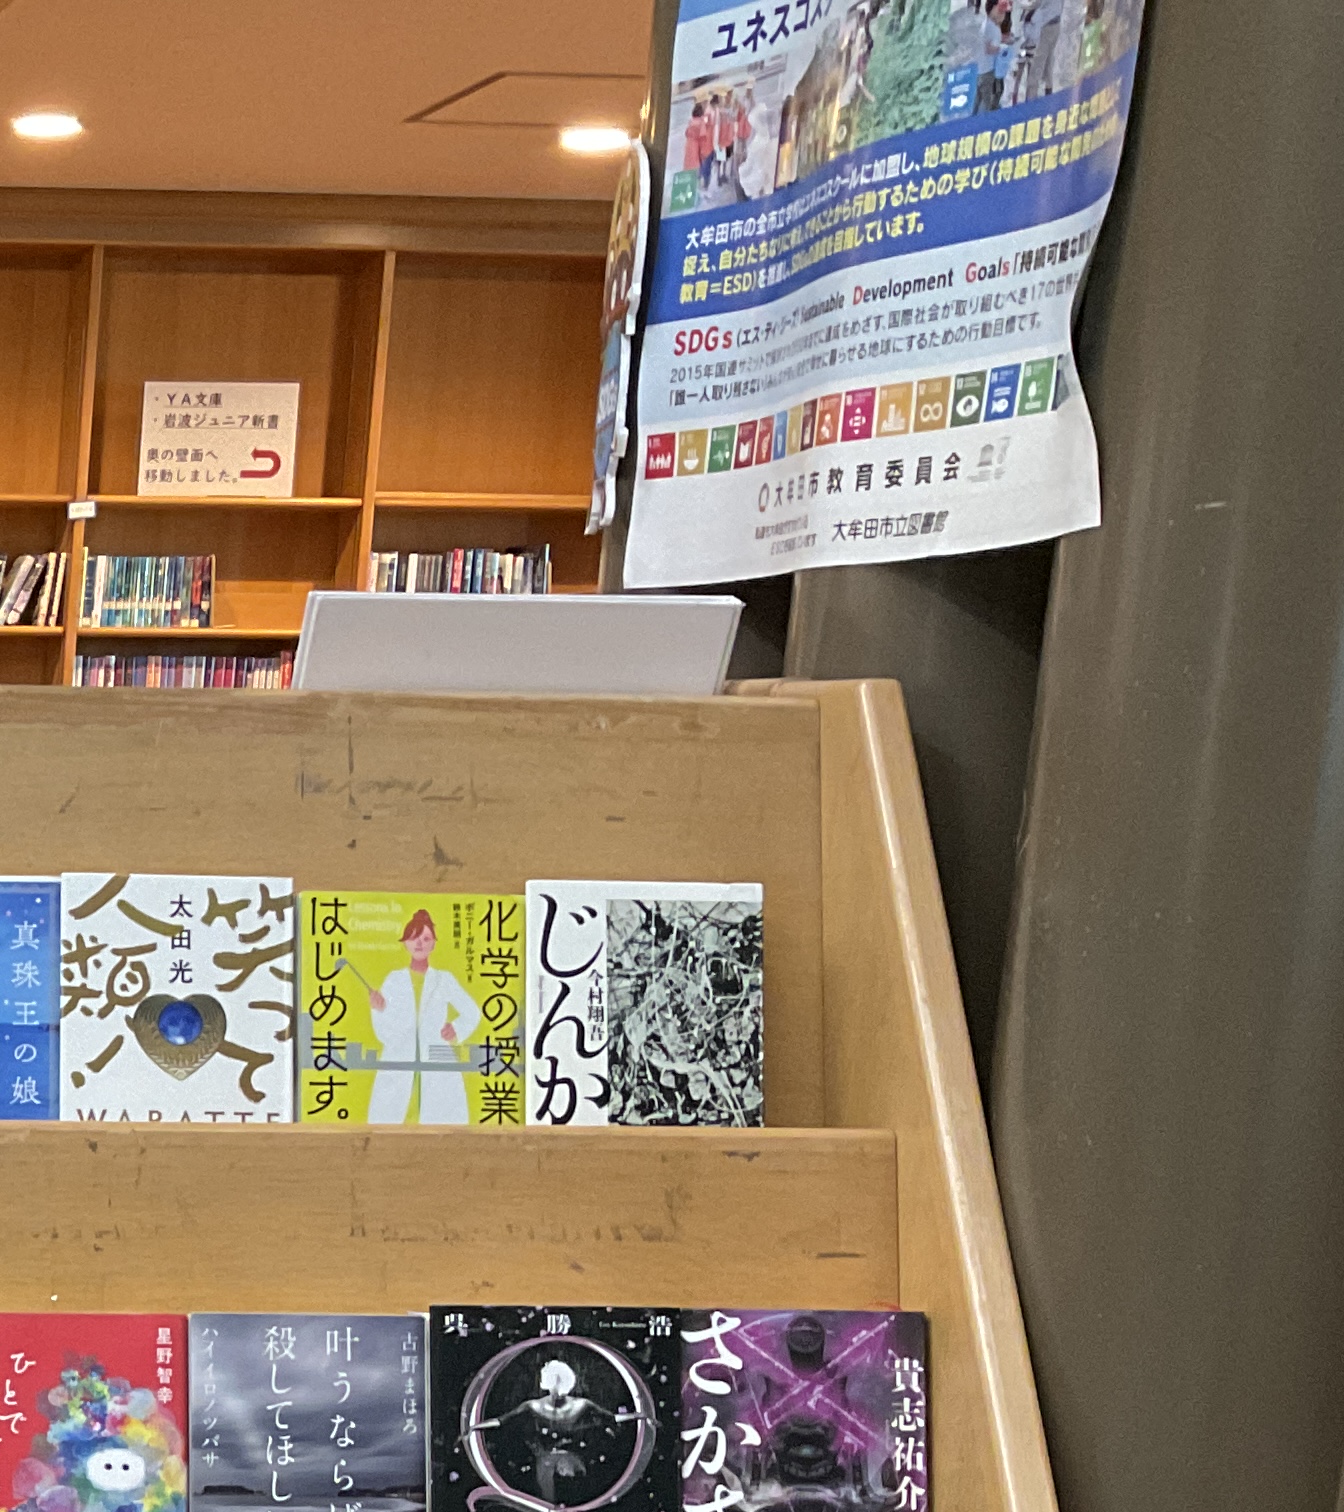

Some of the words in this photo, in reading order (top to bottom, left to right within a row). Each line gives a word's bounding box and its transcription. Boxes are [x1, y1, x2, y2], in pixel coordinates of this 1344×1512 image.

[852, 268, 954, 306] Development
[965, 256, 1011, 284] Goals
[146, 447, 219, 463] 奥の壁面へ
[163, 413, 279, 429] 岩波ジュニア新書
[144, 468, 239, 484] 移動しました。
[168, 893, 194, 984] 太田光
[8, 920, 41, 1107] 真珠王の娘
[307, 896, 350, 1121] はじめます。
[478, 899, 521, 1126] 化学の授業
[532, 892, 612, 1127] じんか
[586, 968, 605, 1042] 今村翔吾
[155, 1326, 173, 1405] 星野智幸
[890, 1356, 927, 1511] 貴志祐介
